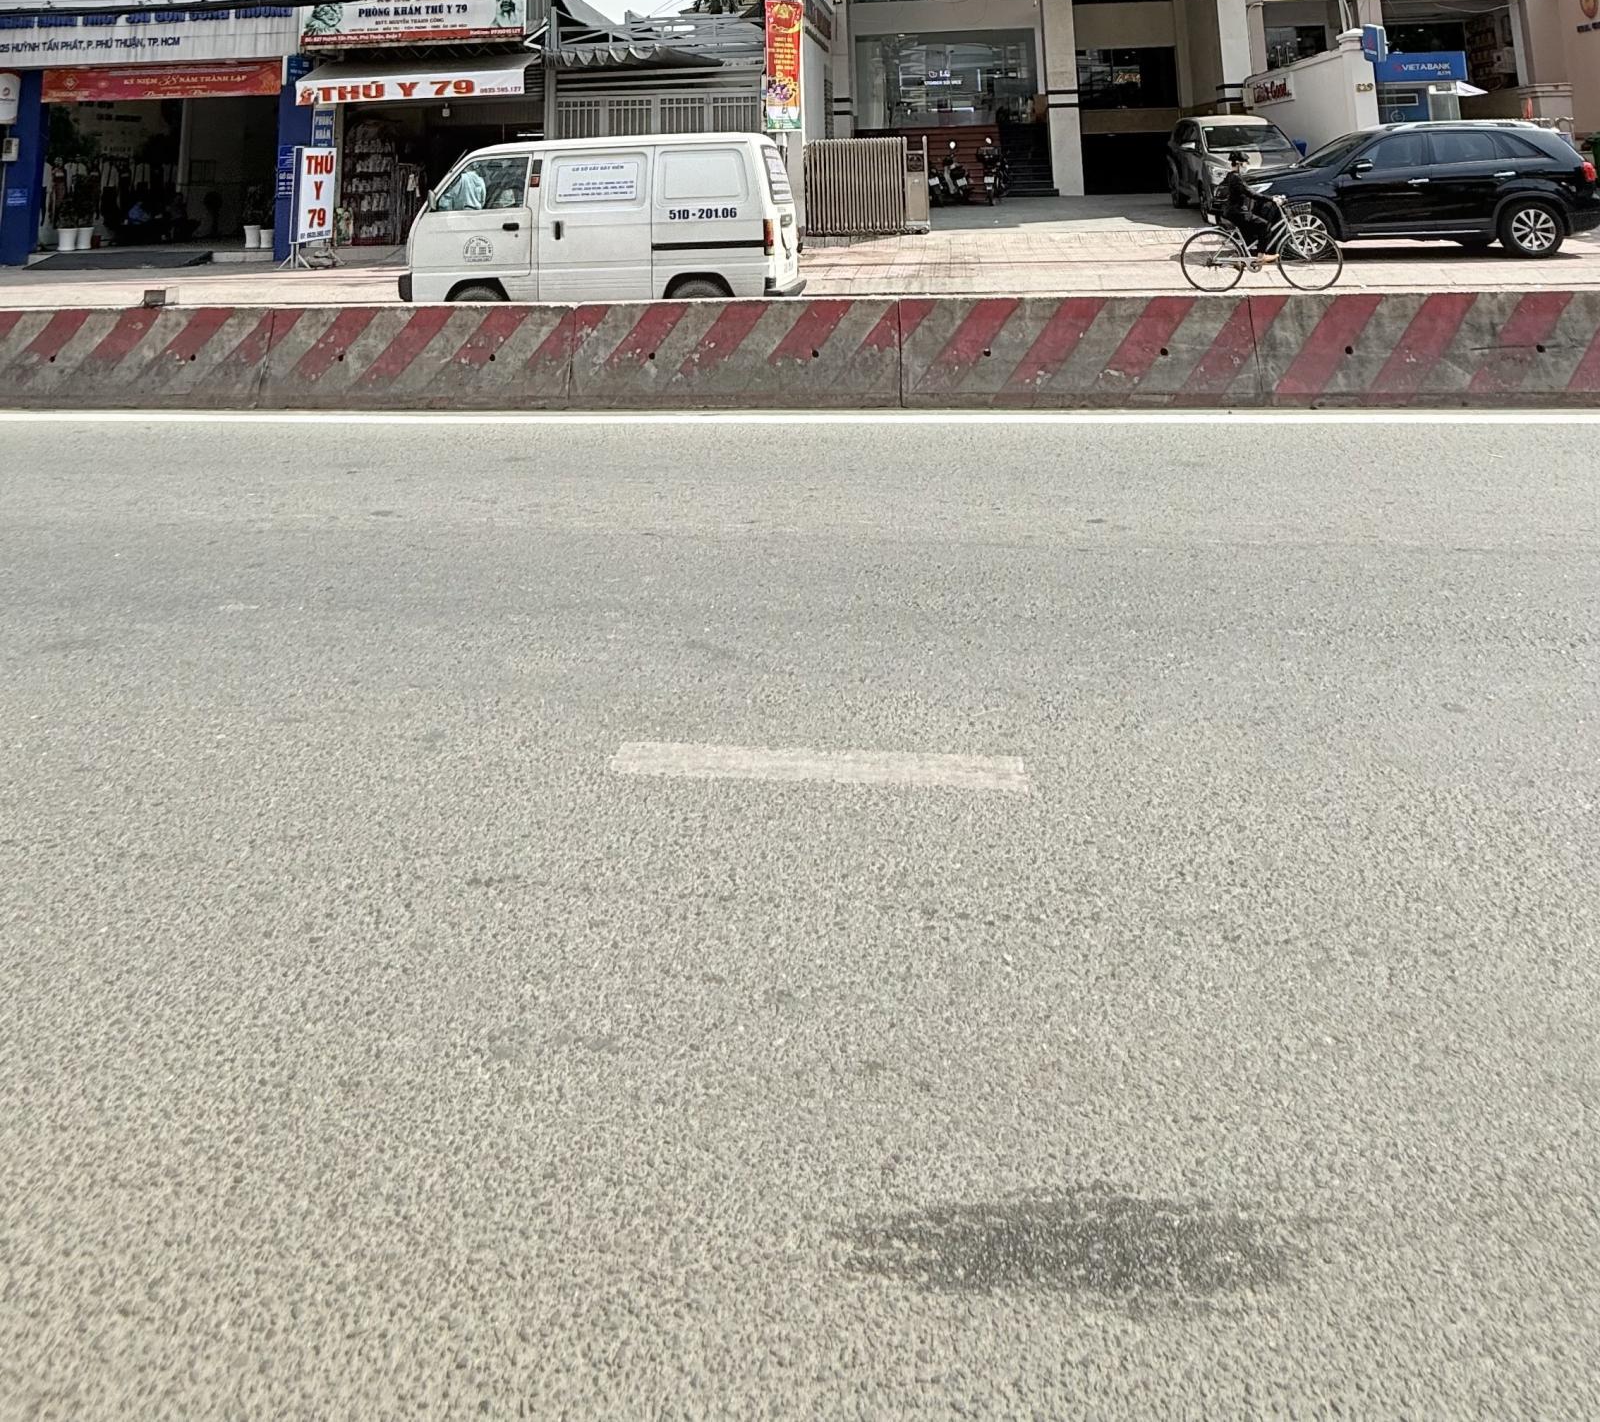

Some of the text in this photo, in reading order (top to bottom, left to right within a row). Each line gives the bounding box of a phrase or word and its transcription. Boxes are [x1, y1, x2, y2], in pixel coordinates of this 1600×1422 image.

[358, 3, 468, 18] PHÒNG KHÁM THÚ Y 79
[0, 43, 10, 53] 25
[11, 40, 40, 53] HUỲNH
[42, 37, 60, 52] TẤN
[96, 37, 114, 50] PHÚ
[161, 36, 180, 47] HCM
[1401, 62, 1451, 72] VIETABANK
[316, 80, 385, 103] THÚ
[397, 81, 420, 98] Y
[429, 79, 475, 96] 79
[306, 151, 334, 175] THÚ
[314, 180, 324, 201] Y
[308, 208, 327, 229] 79
